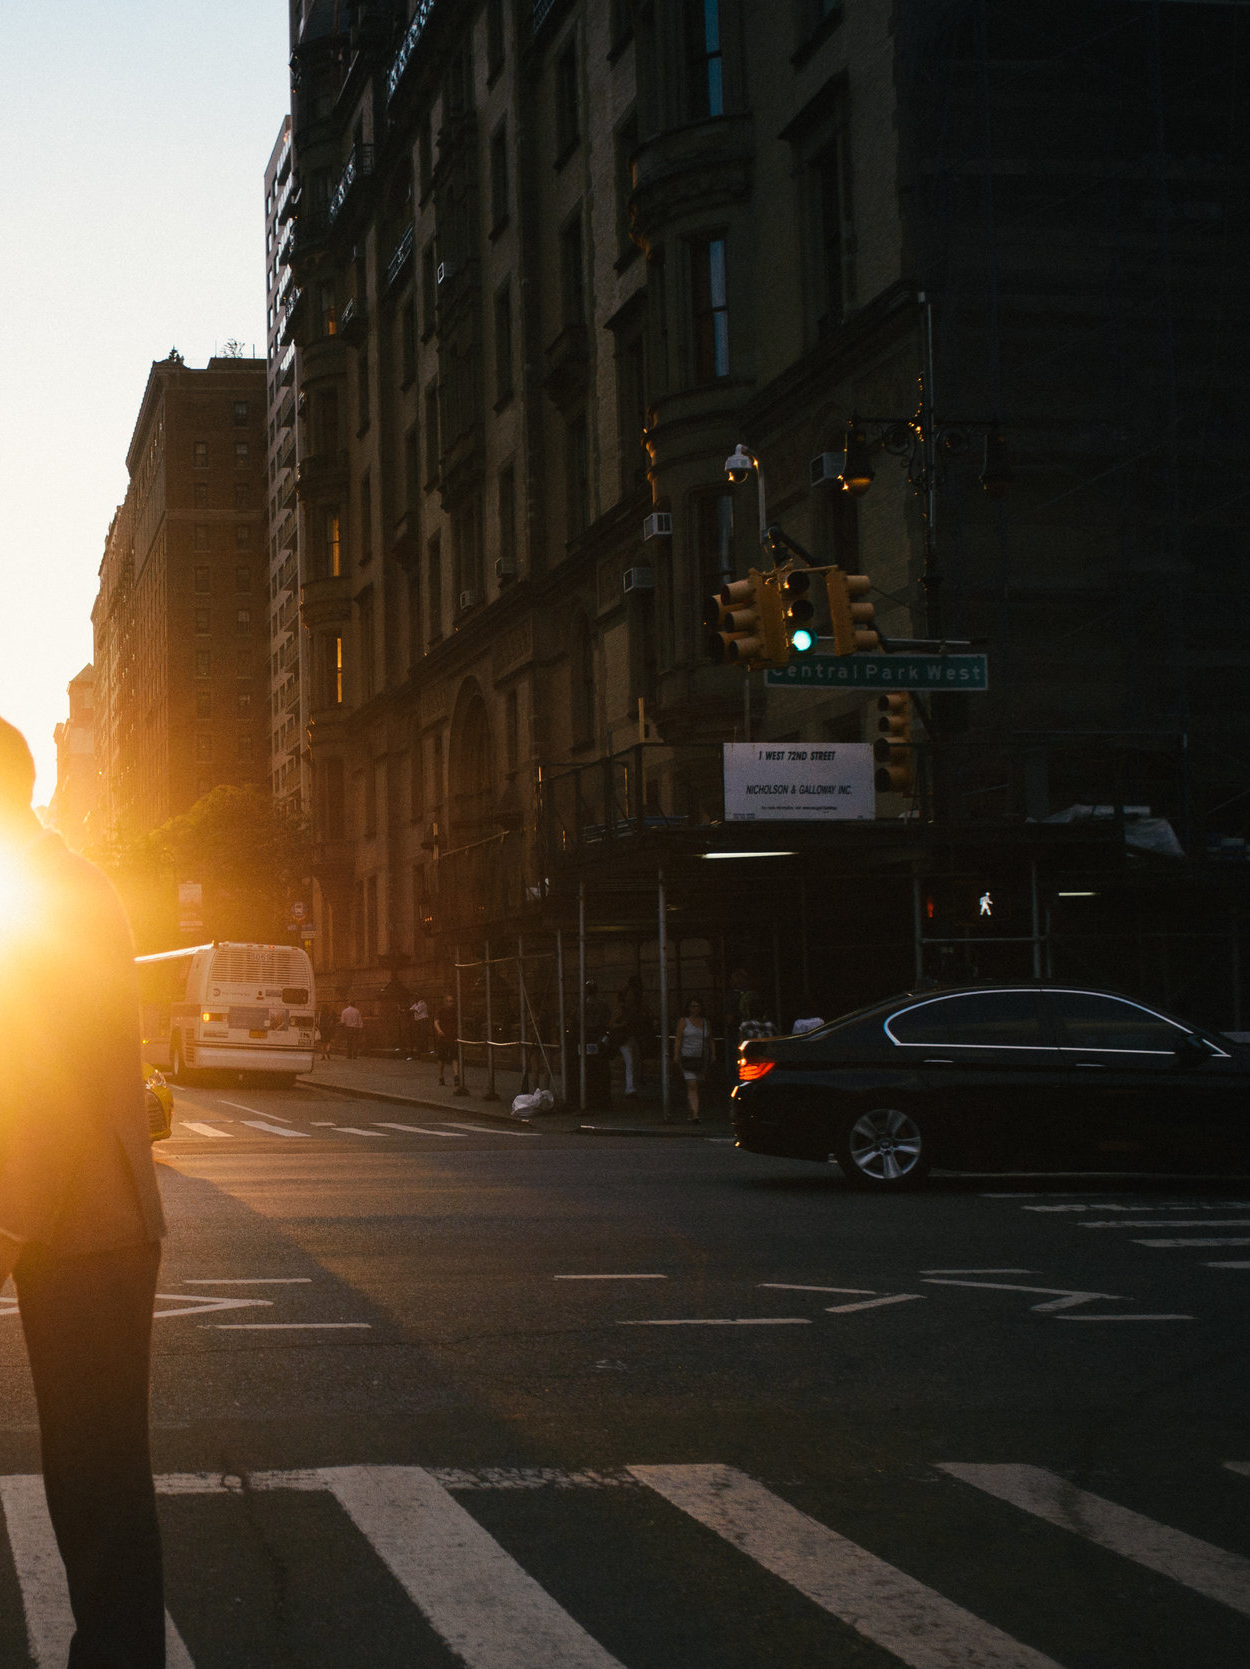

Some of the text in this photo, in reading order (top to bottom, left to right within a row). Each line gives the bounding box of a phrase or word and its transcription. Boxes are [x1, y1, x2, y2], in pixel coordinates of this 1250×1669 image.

[866, 664, 919, 680] Park
[927, 665, 981, 681] West
[765, 751, 785, 760] WEST
[787, 751, 807, 760] 72ND
[810, 751, 836, 761] STREET
[745, 785, 853, 795] NICHOLSON & GALLOWAY INC.
